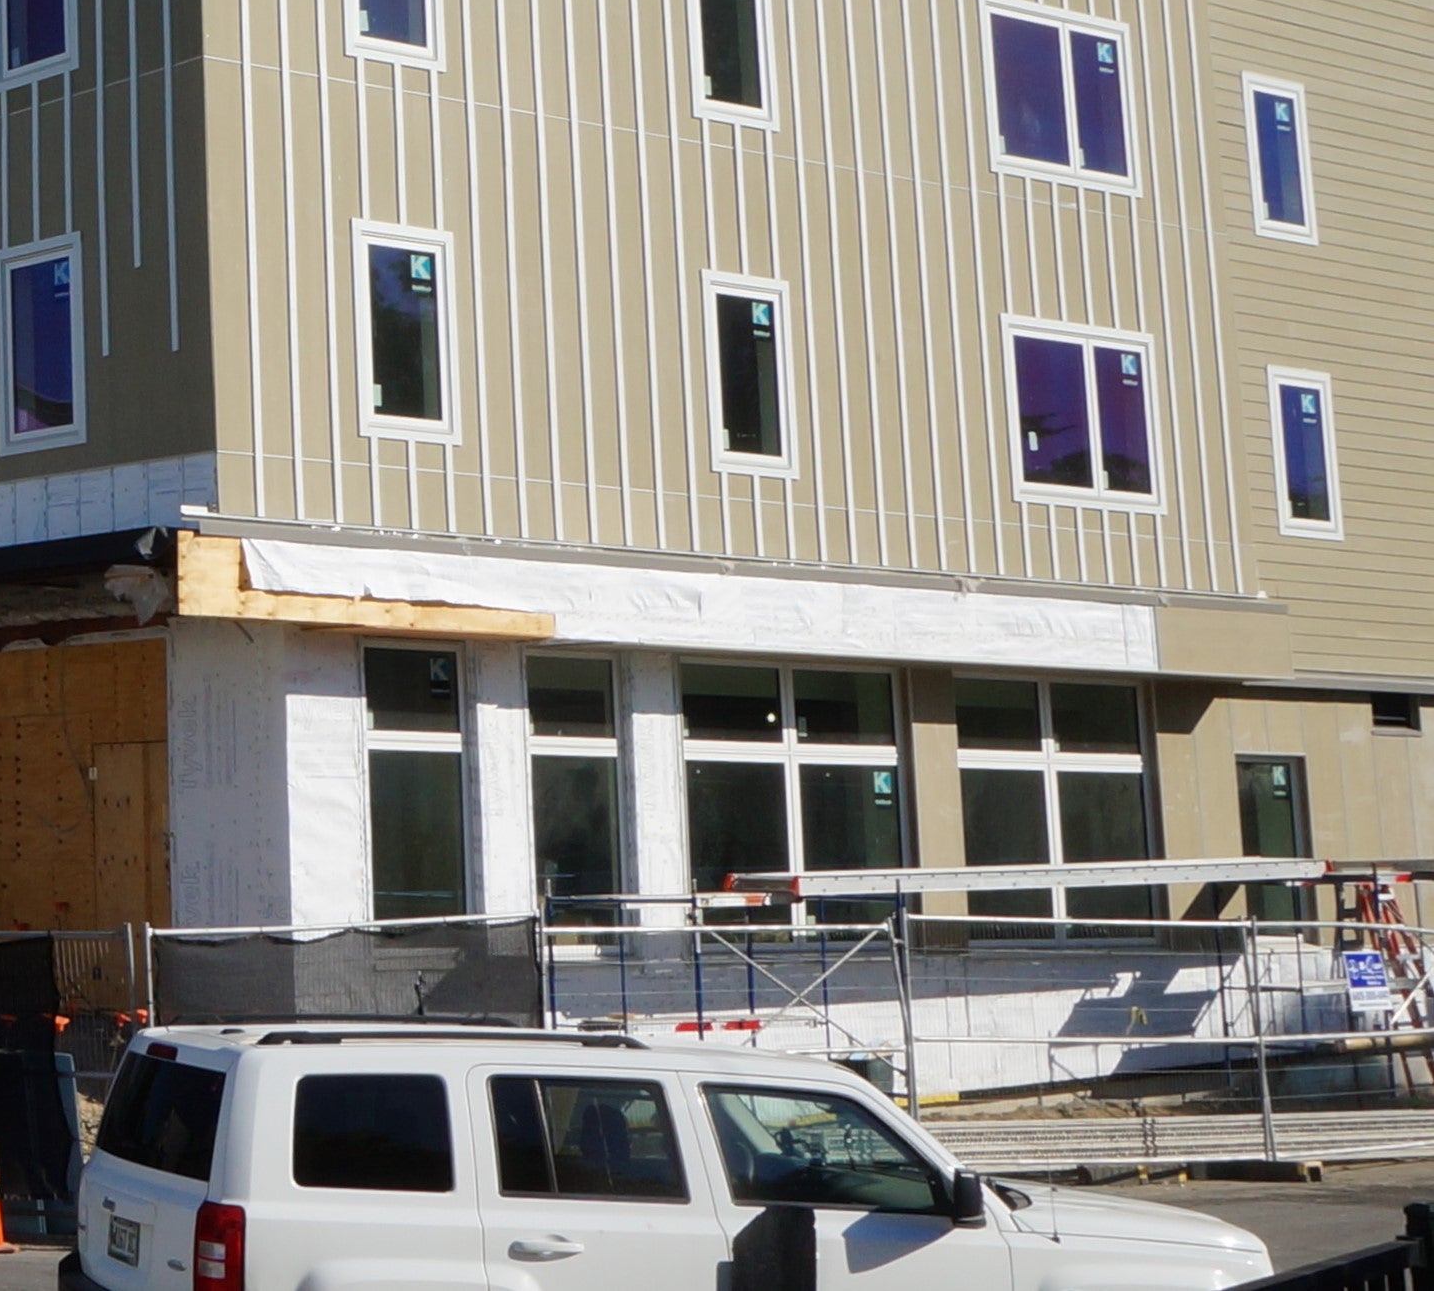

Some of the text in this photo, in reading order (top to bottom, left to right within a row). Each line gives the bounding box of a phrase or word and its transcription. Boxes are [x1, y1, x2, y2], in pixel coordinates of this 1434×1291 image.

[411, 255, 431, 280] K
[752, 302, 770, 326] K
[1121, 354, 1137, 375] K
[1301, 394, 1316, 414] K
[430, 658, 449, 680] K
[178, 694, 203, 793] Tyvek
[873, 771, 891, 793] K
[1272, 765, 1286, 785] K
